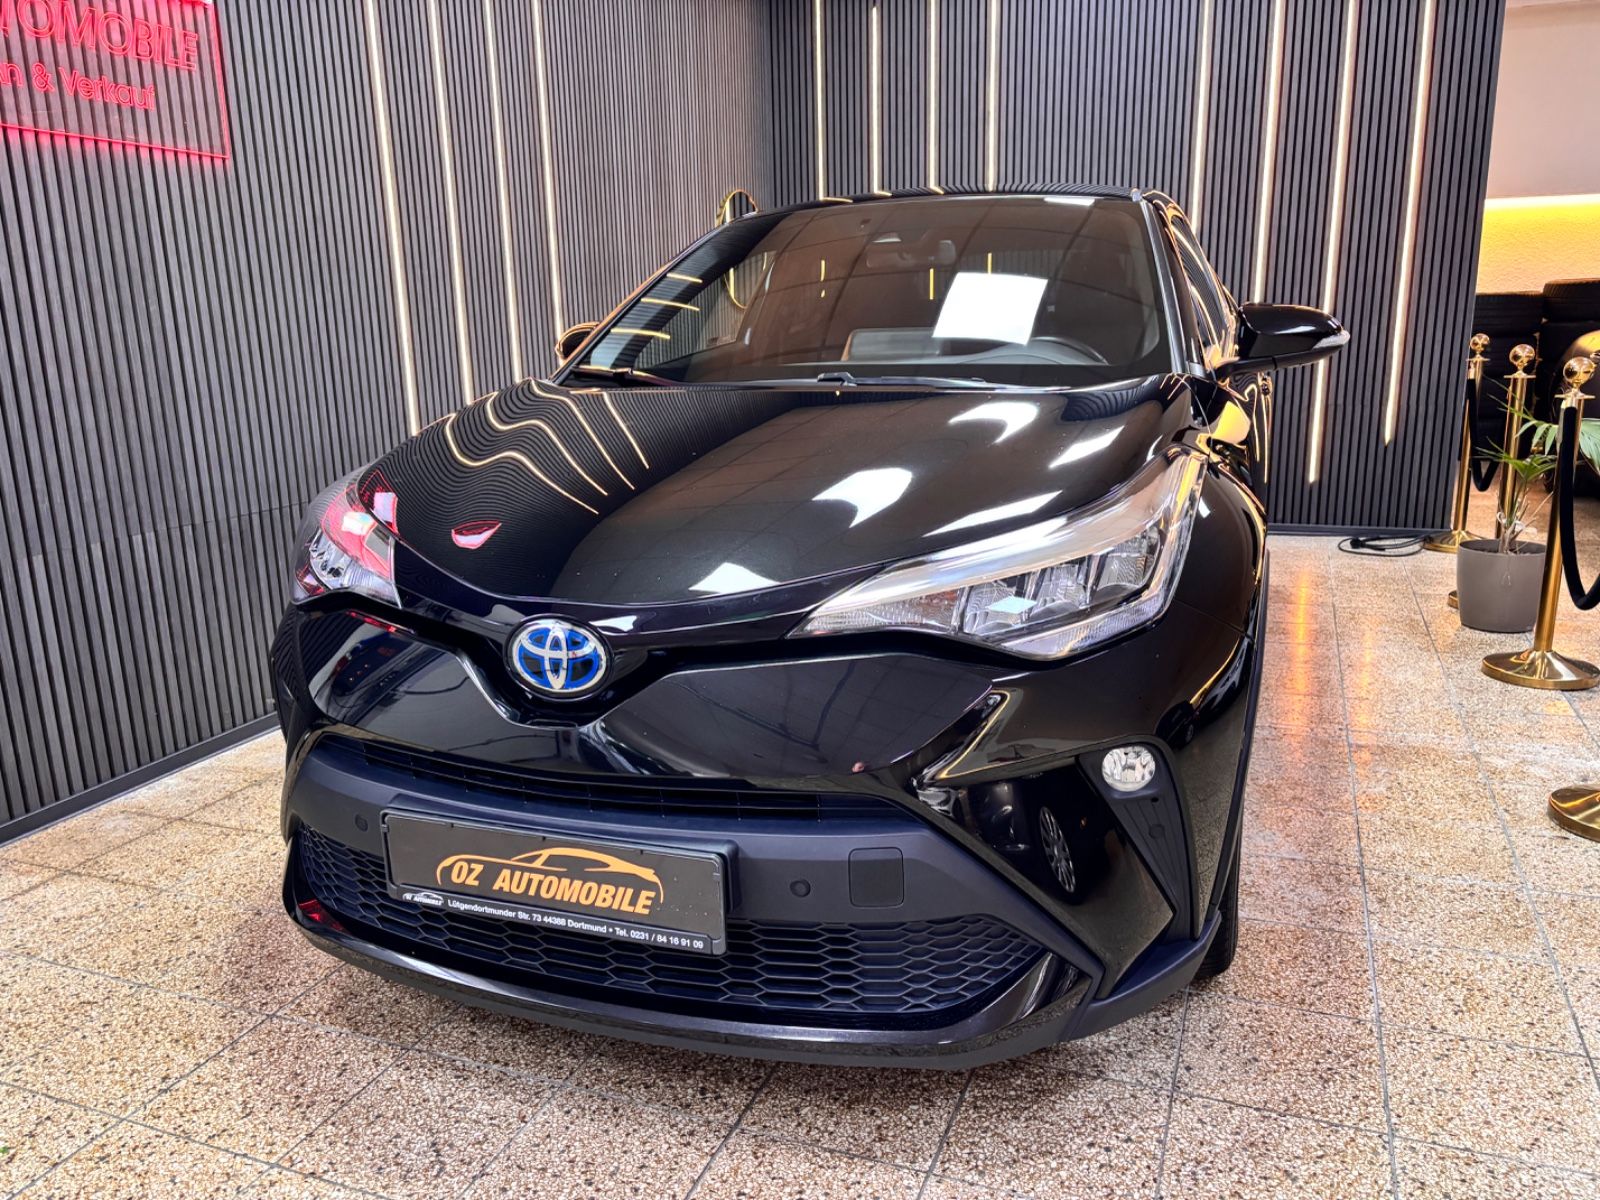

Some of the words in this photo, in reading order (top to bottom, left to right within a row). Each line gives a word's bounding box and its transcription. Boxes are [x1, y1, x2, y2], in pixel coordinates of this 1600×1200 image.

[0, 62, 23, 87] n
[31, 62, 55, 92] &
[58, 66, 155, 111] Verkauf
[451, 861, 484, 887] OZ
[493, 869, 656, 915] AUTOMOBILE
[532, 913, 542, 922] 73
[567, 919, 607, 933] Dortmund
[614, 927, 629, 937] Tel.
[630, 930, 649, 940] 0231
[656, 934, 667, 943] 84
[680, 938, 690, 947] 91
[692, 940, 704, 949] 09
